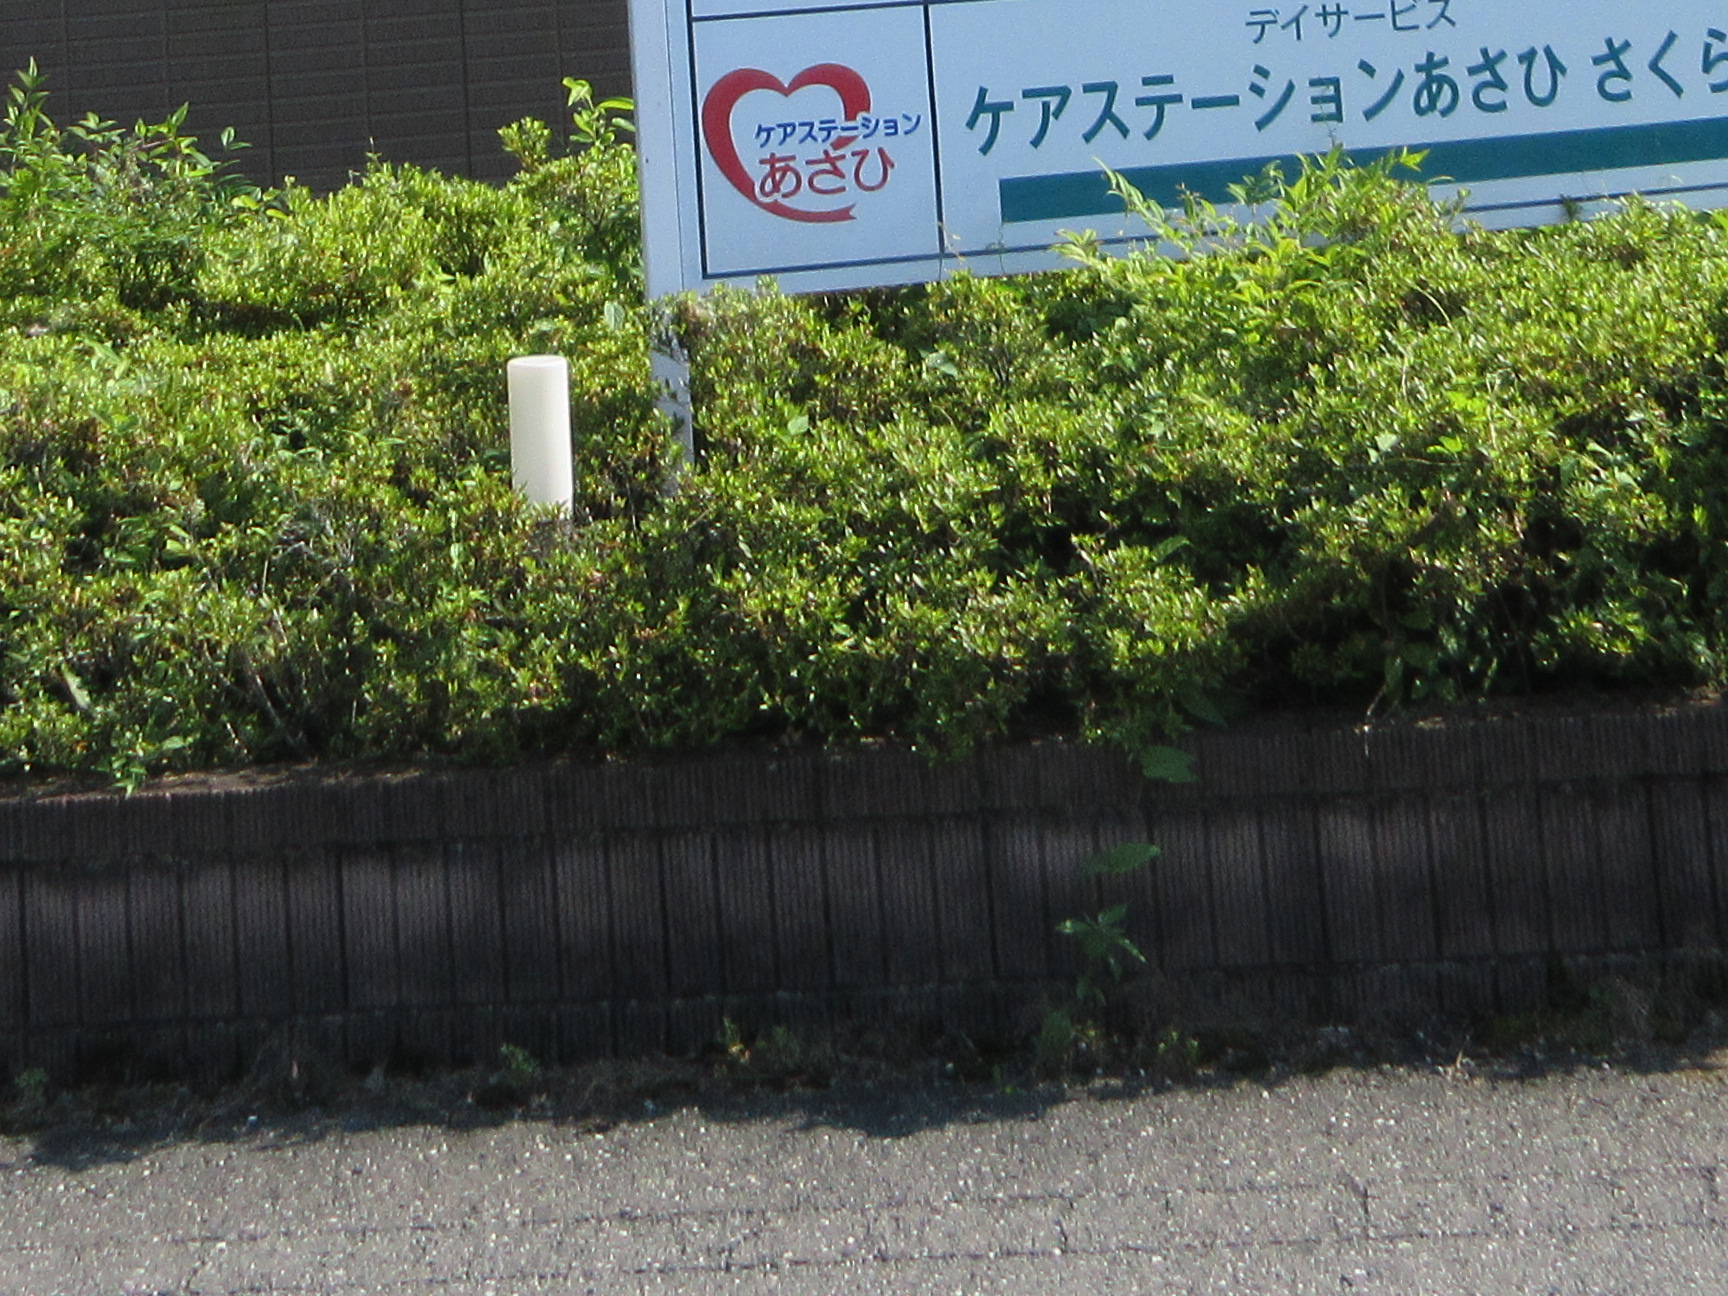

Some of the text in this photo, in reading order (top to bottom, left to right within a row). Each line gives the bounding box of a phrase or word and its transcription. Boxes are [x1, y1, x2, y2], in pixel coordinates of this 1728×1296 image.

[964, 42, 1568, 157] ケアステーションあさひ
[753, 111, 923, 150] ケアステーション
[757, 145, 896, 200] あさひ
